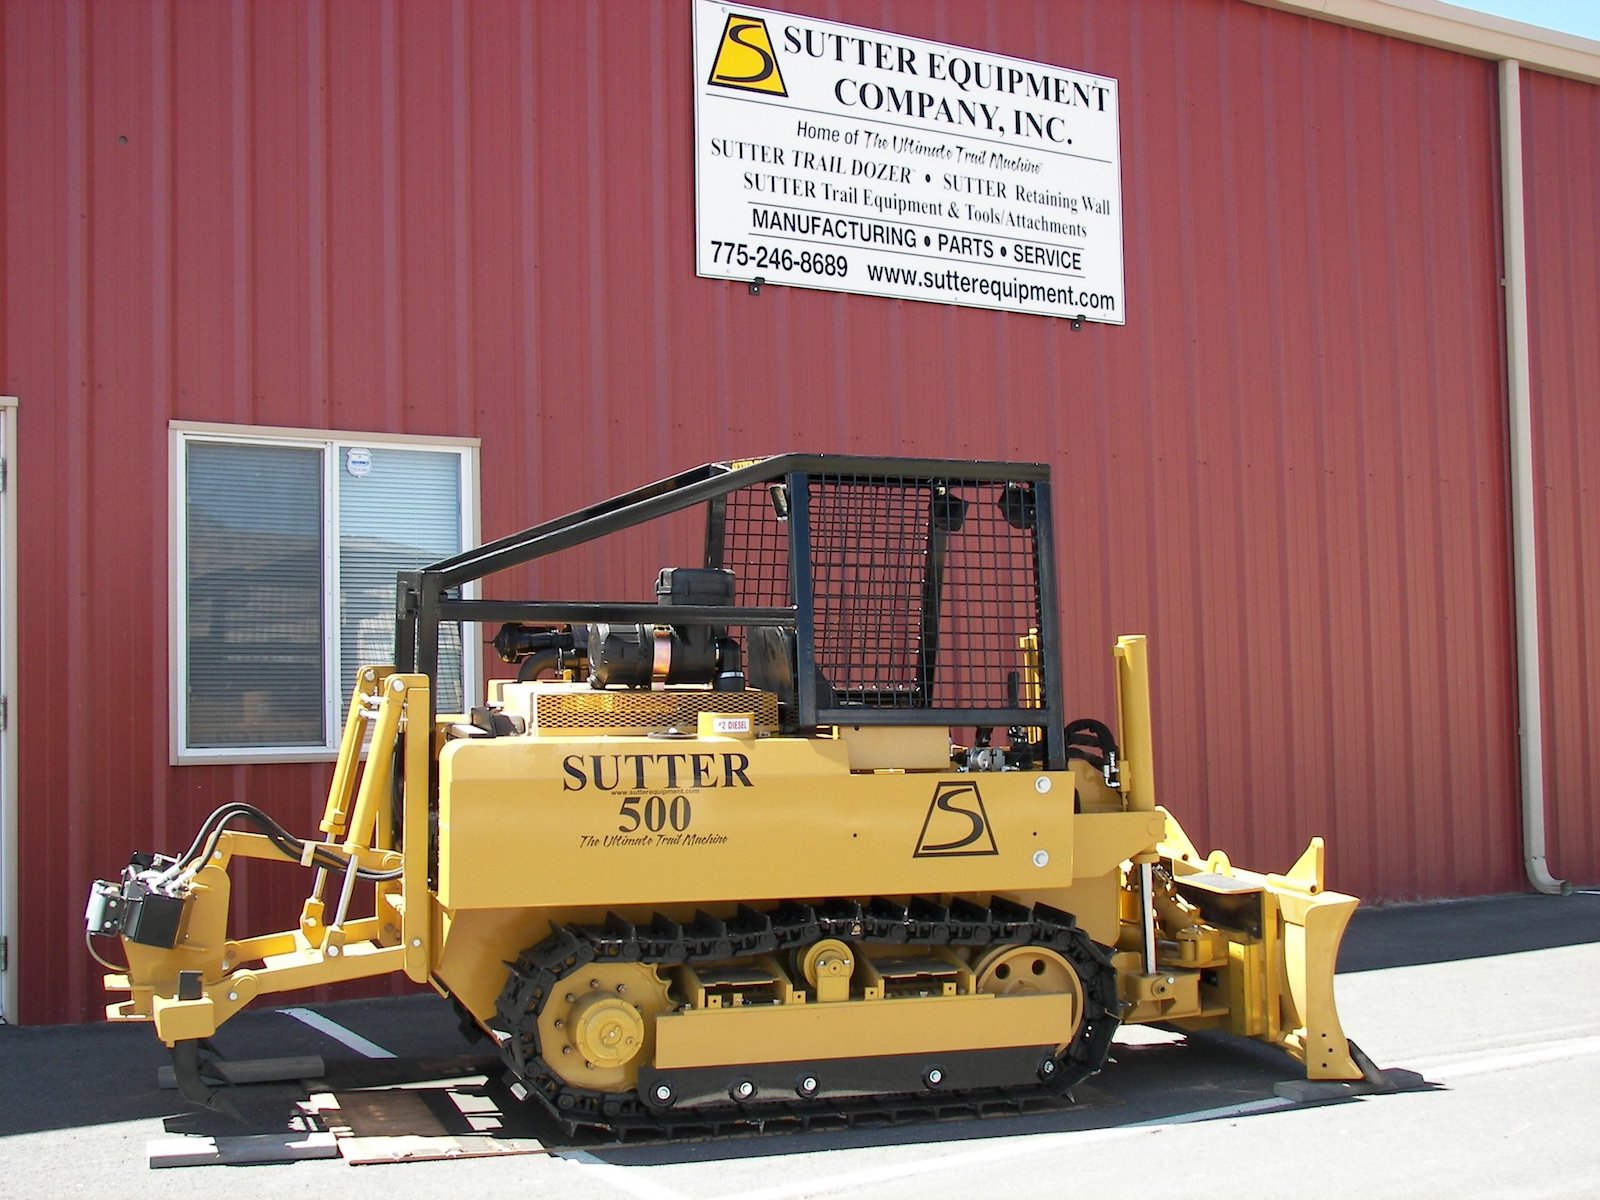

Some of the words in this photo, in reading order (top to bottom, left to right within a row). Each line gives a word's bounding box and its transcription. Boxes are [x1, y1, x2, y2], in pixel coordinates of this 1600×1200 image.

[784, 25, 918, 76] SUTTER
[928, 52, 1110, 112] EQUIPMENT
[834, 78, 1005, 138] COMPANY,
[1013, 109, 1073, 145] INC.
[711, 137, 785, 166] SUTTER
[792, 149, 847, 175] TRAIL
[851, 158, 912, 184] DOZER
[943, 172, 1007, 199] SUTTER
[1015, 184, 1078, 214] Retaining
[1081, 195, 1111, 216] Wall
[797, 121, 840, 144] Home
[845, 129, 860, 146] of
[864, 130, 890, 150] The
[892, 135, 953, 161] Ultimate
[955, 145, 987, 167] Trail
[989, 152, 1042, 175] Machine
[744, 171, 817, 198] SUTTER
[821, 182, 858, 205] Trail
[863, 188, 943, 216] Equipment
[948, 201, 960, 219] &
[965, 203, 1087, 238] Tools/Attachments
[752, 208, 917, 248] MANUFACTURING
[938, 233, 994, 259] PARTS
[1014, 244, 1082, 270] SERVICE
[711, 240, 848, 278] 775-246-8689
[867, 264, 1115, 311] www.sutterequipment.com
[727, 720, 747, 730] DIESEL
[562, 752, 754, 792] SUTTER
[611, 787, 700, 796] www.sutterequipment.com
[580, 835, 600, 848] The
[603, 834, 652, 848] Ultimate
[655, 834, 682, 847] Trail
[682, 833, 728, 847] Machine
[618, 795, 692, 833] 500
